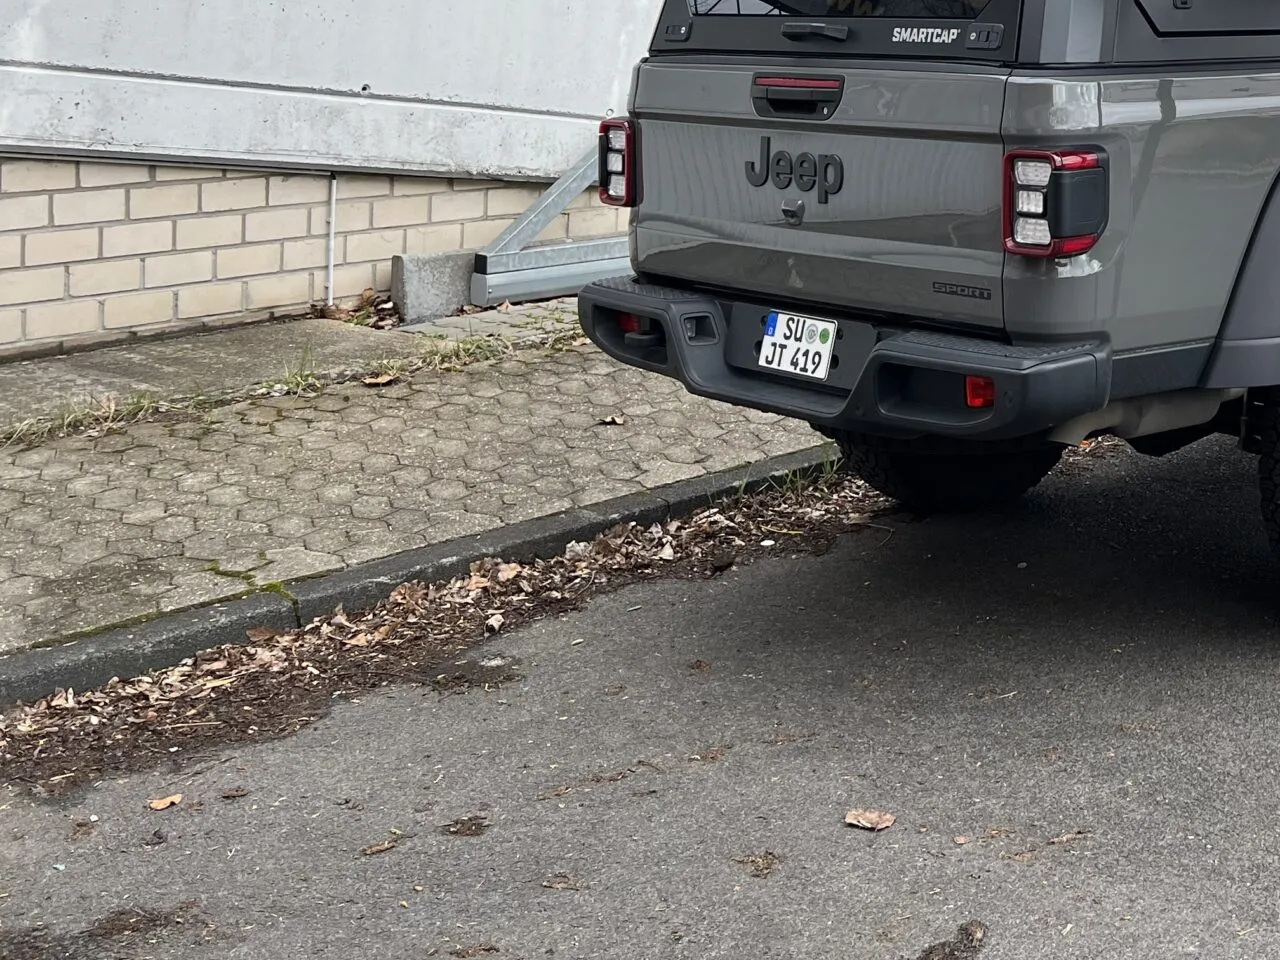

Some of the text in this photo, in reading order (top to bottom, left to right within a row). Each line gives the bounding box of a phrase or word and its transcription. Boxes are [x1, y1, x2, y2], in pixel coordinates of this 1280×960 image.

[892, 27, 958, 43] SMARTCAP
[744, 136, 844, 204] Jeep
[932, 281, 992, 300] SPORT
[783, 317, 806, 343] SU
[765, 342, 822, 374] JT 419
